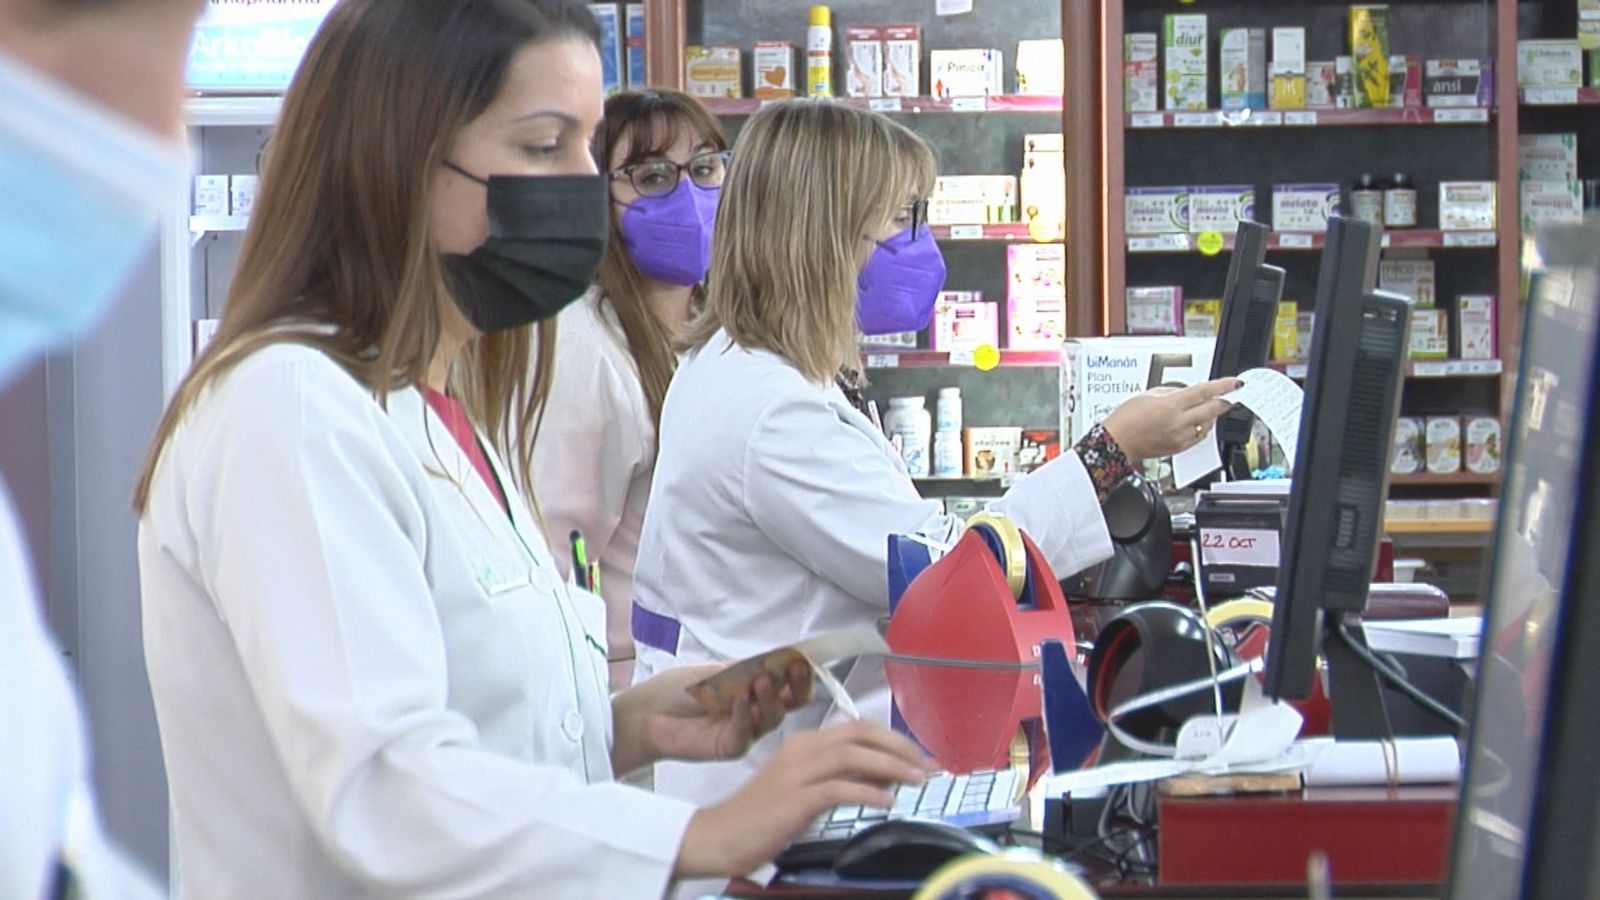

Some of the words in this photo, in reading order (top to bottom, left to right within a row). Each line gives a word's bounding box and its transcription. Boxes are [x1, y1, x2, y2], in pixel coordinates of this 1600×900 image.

[1086, 355, 1138, 368] biManán
[1087, 372, 1113, 382] Plan
[1087, 380, 1142, 393] PROTEÍNA
[1202, 533, 1225, 548] 22
